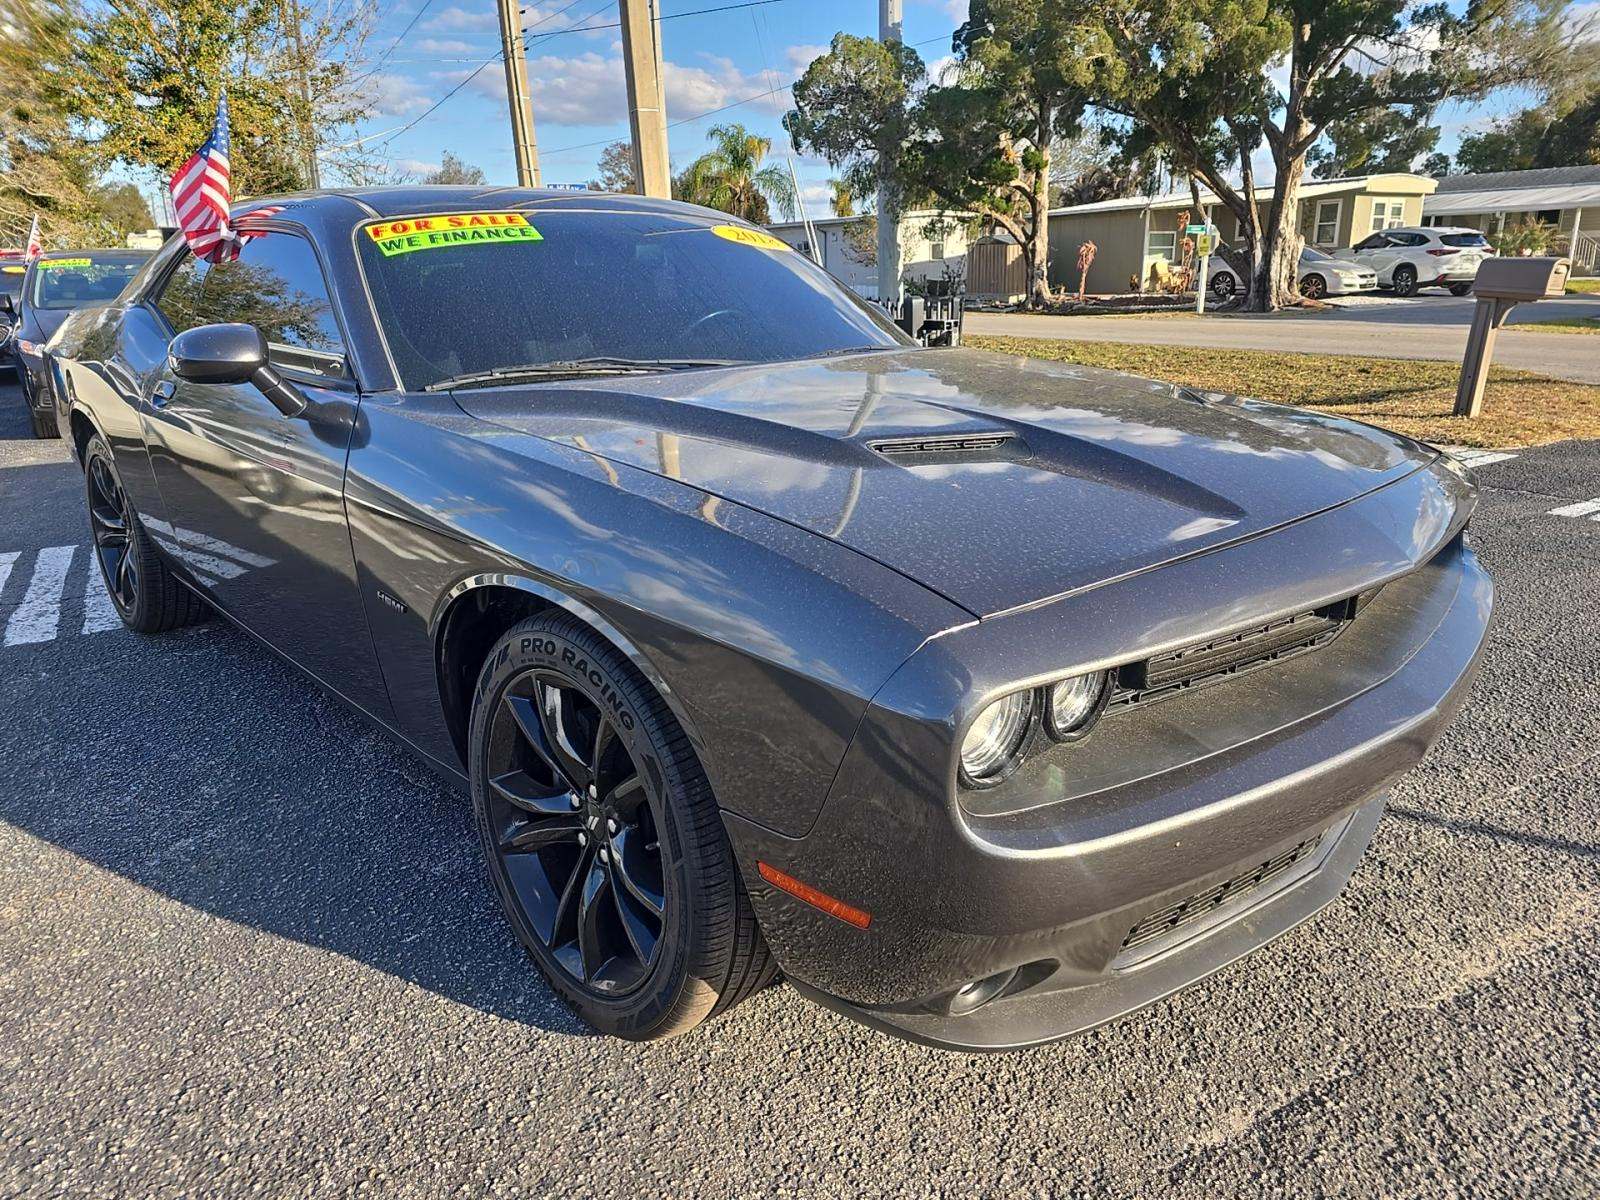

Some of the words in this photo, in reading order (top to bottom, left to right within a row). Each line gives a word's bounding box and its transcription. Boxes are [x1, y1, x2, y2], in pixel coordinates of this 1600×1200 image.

[371, 218, 433, 238] FOR
[448, 214, 520, 227] SALE
[382, 237, 420, 251] WE
[429, 227, 532, 244] FINANCE
[520, 637, 556, 656] PRO
[562, 646, 635, 731] RACING
